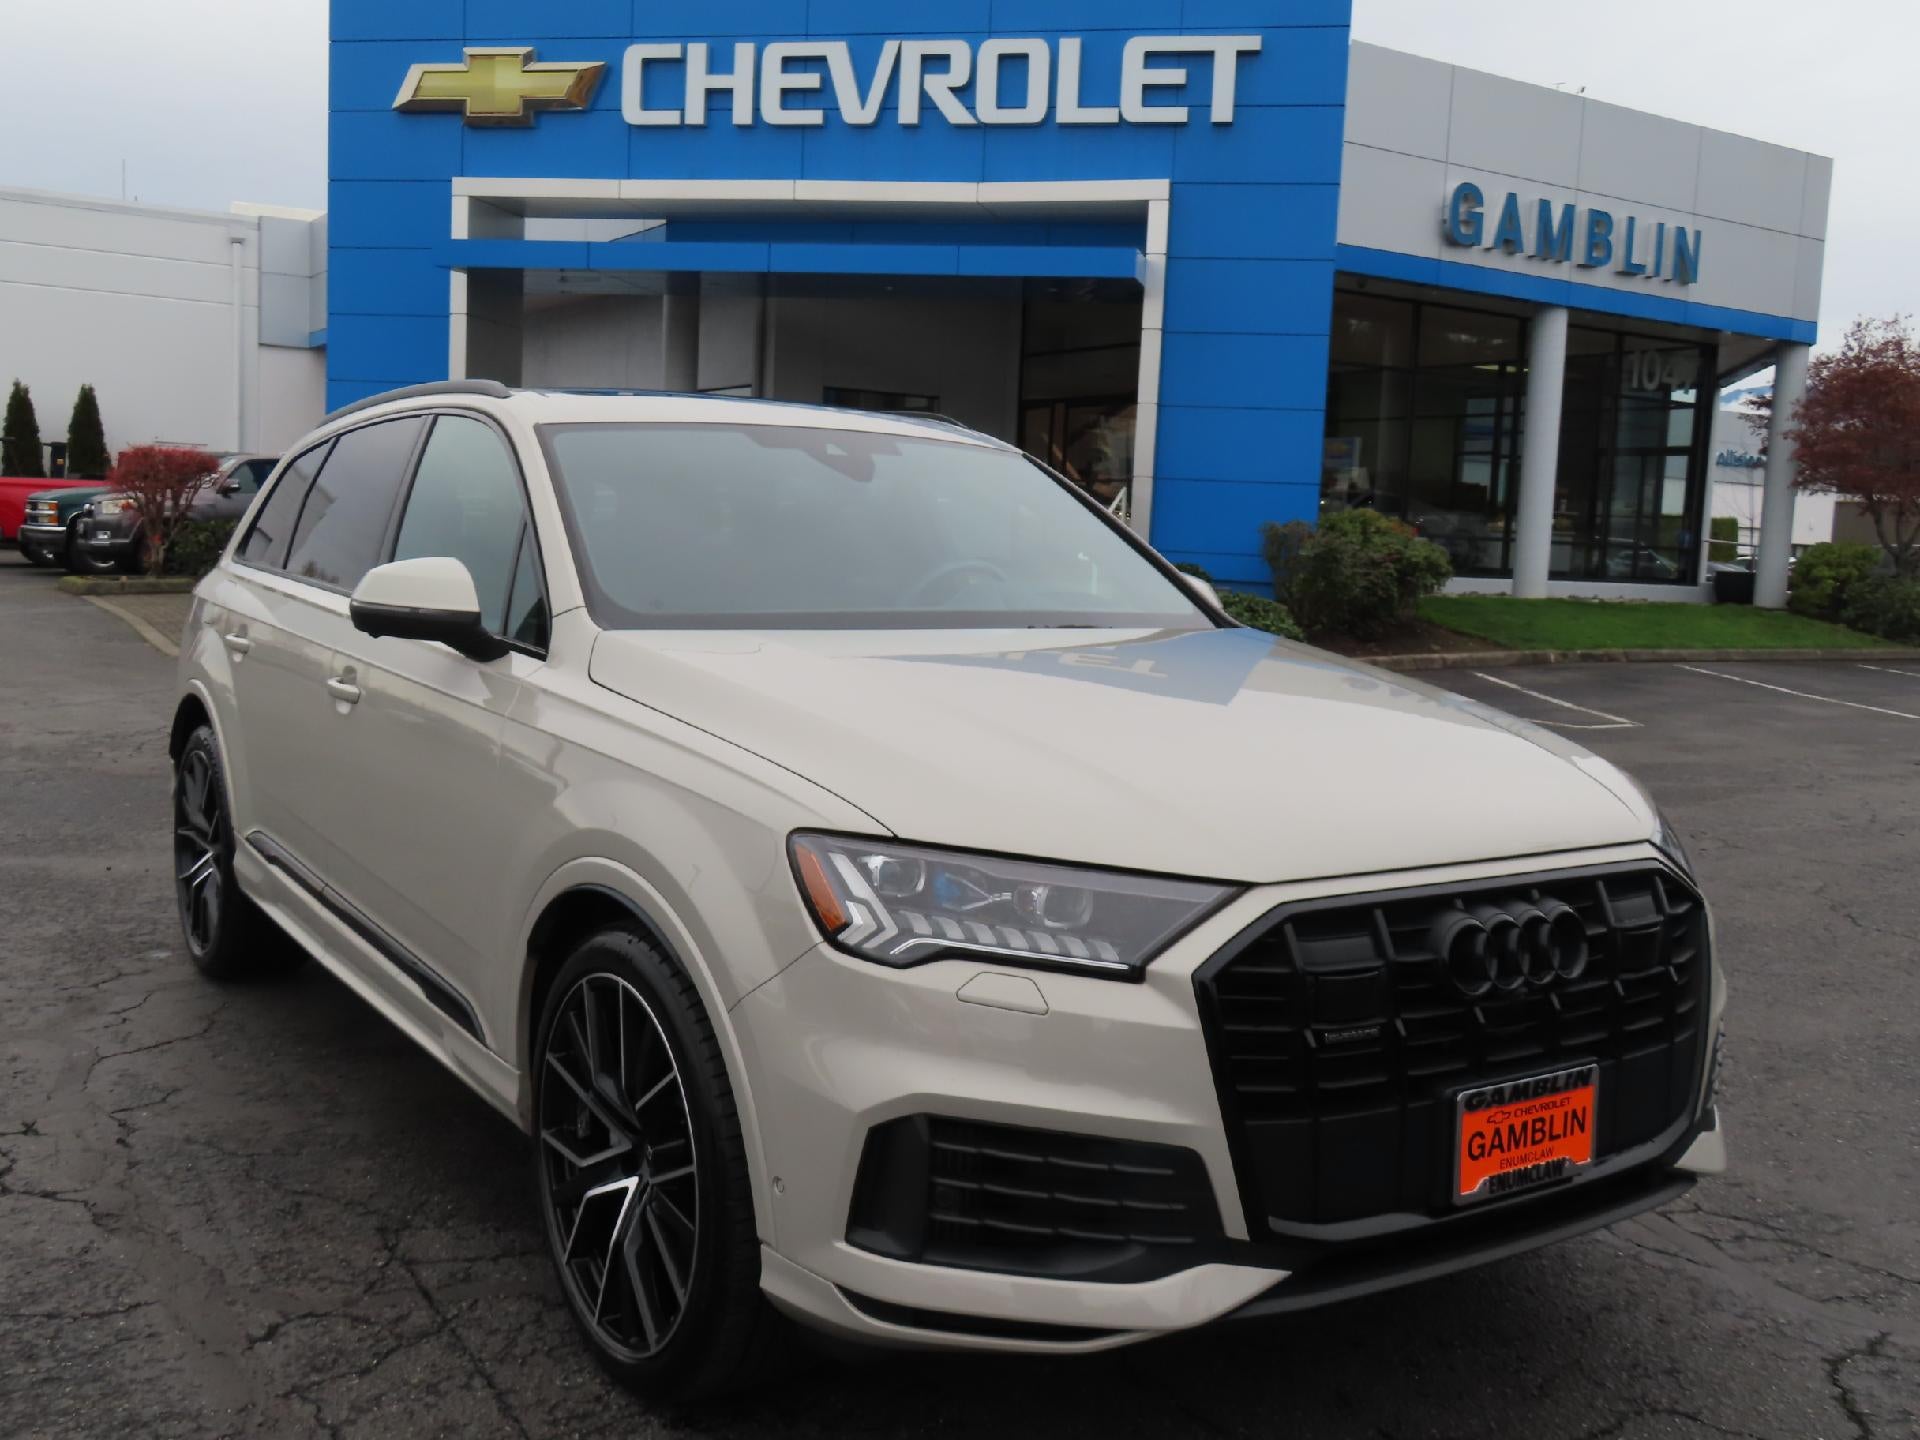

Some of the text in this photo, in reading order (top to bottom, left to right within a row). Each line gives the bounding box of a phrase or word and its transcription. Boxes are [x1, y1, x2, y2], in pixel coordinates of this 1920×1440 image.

[621, 35, 1262, 126] CHEVROLET
[1445, 182, 1702, 285] GAMBLIN
[1464, 1067, 1593, 1112] GAMBLIN
[1513, 1096, 1571, 1118] CHEVROLET
[1467, 1105, 1587, 1162] GAMBLIN
[1488, 1157, 1567, 1194] ENUMCLAW
[1499, 1146, 1554, 1170] ENUMCLAW
